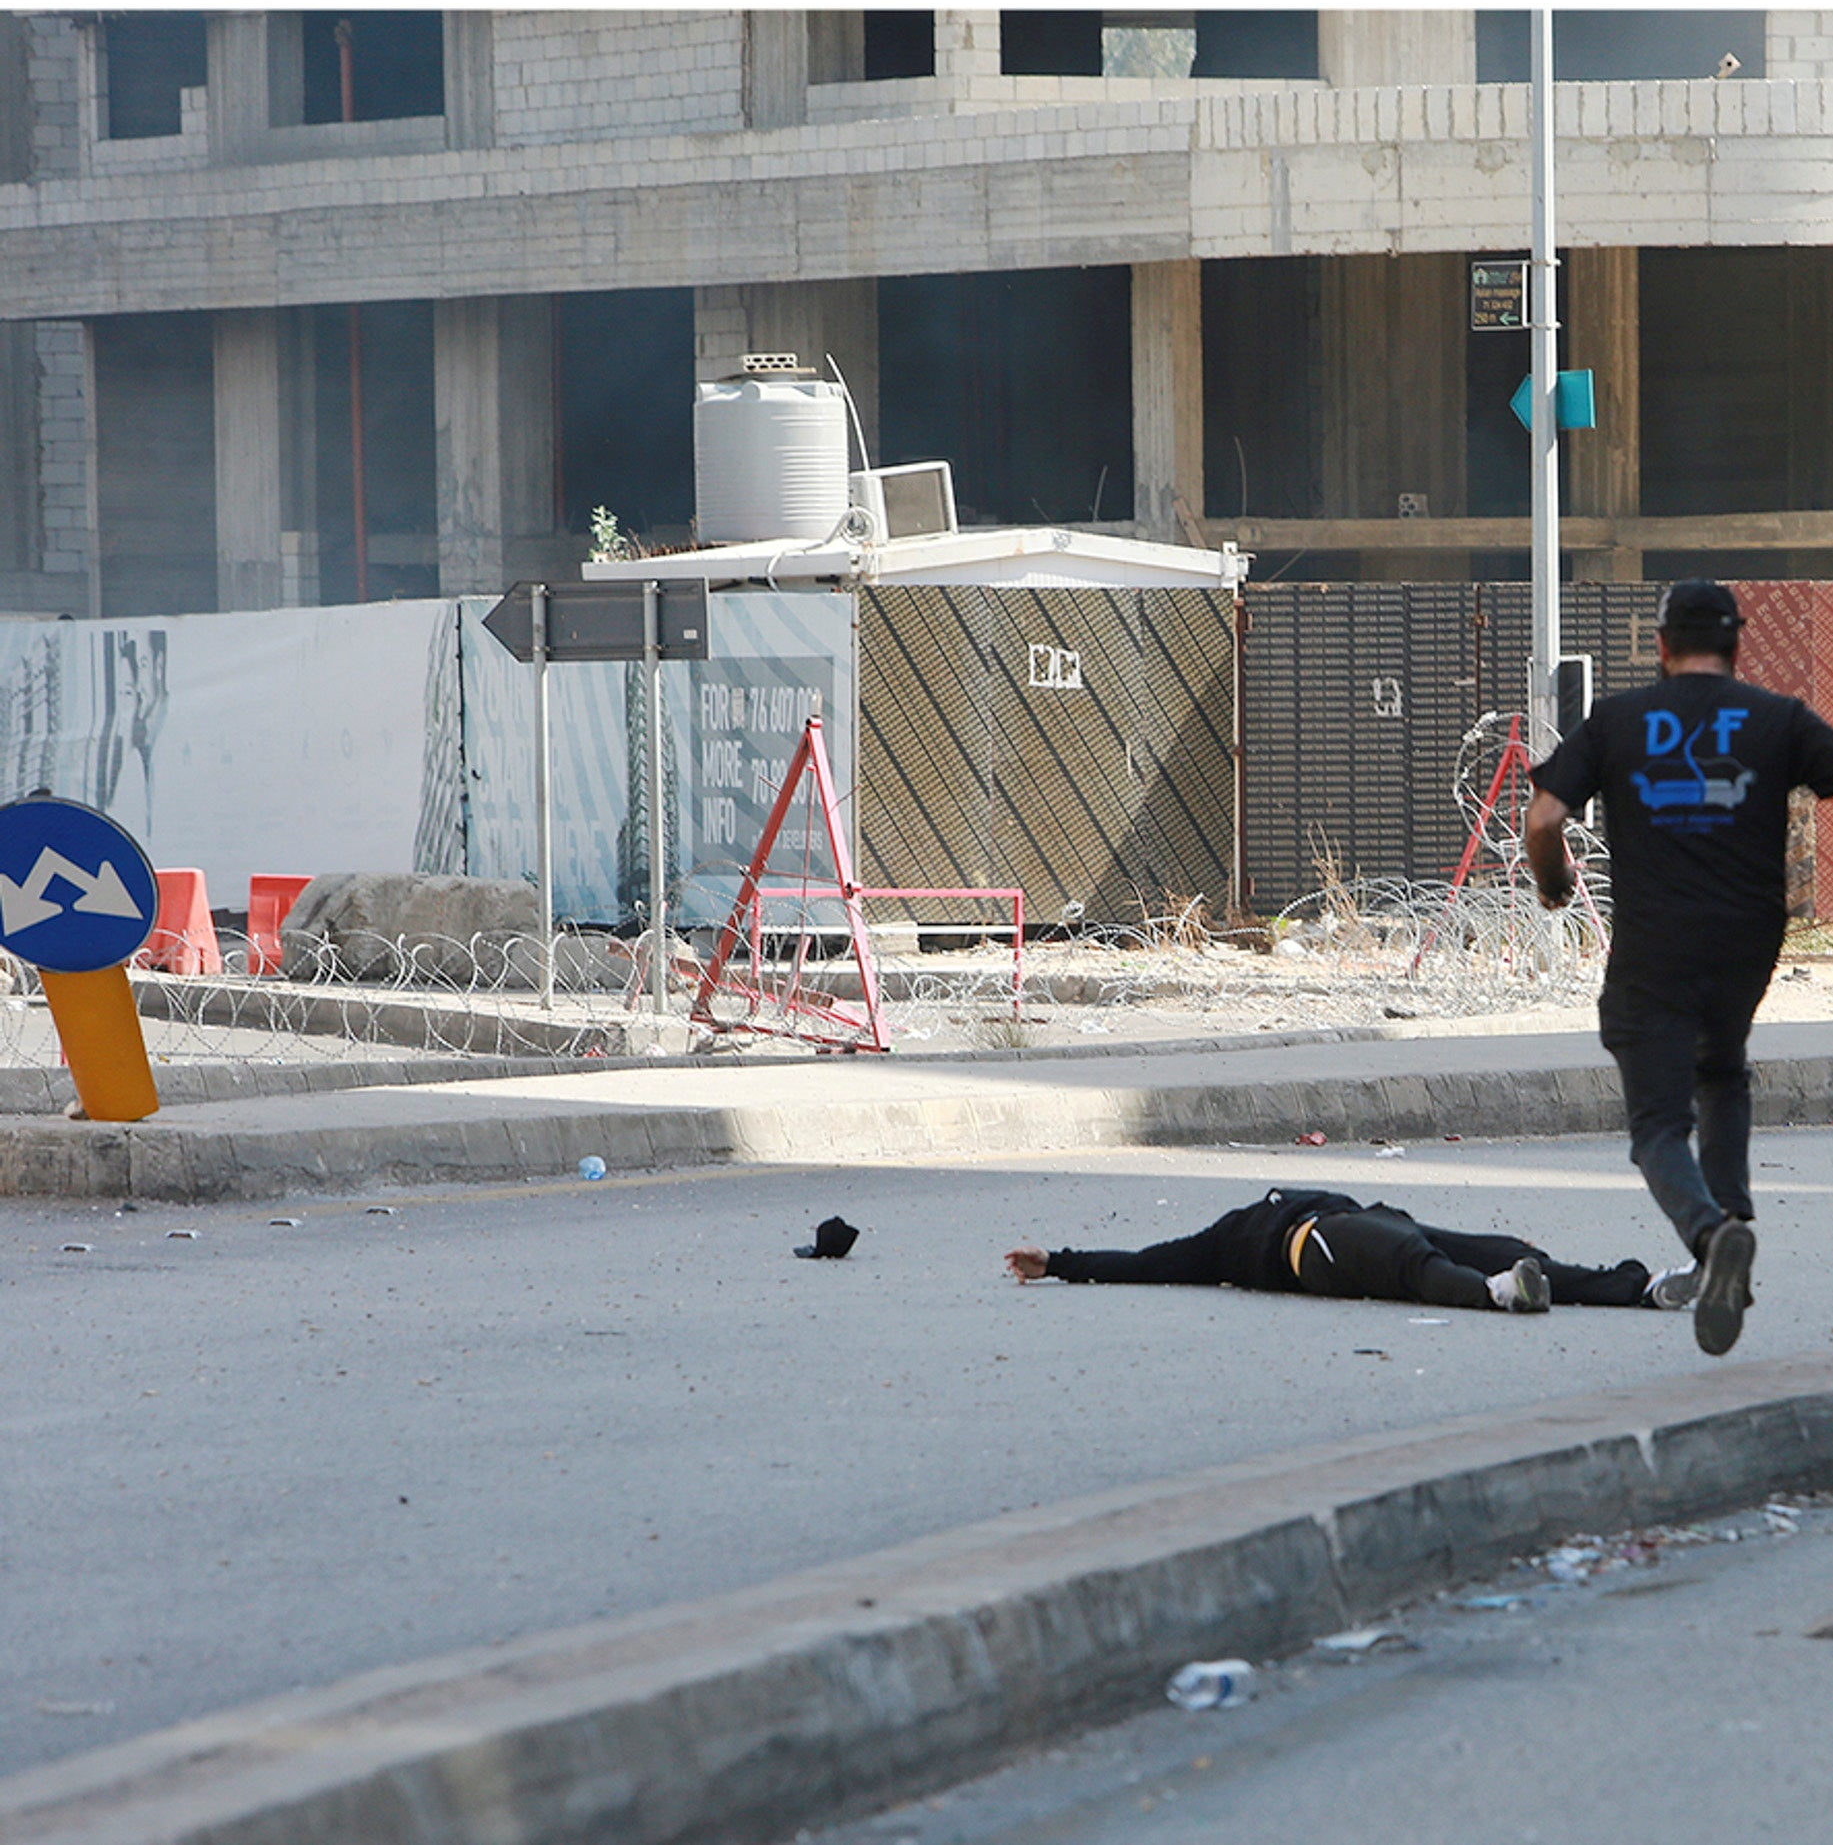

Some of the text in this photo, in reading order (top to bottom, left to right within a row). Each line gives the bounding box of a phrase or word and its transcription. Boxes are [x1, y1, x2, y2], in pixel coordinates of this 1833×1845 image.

[1755, 602, 1809, 673] Europlus
[702, 684, 729, 731] FOR
[703, 740, 743, 788] MORE
[703, 796, 736, 845] INFO
